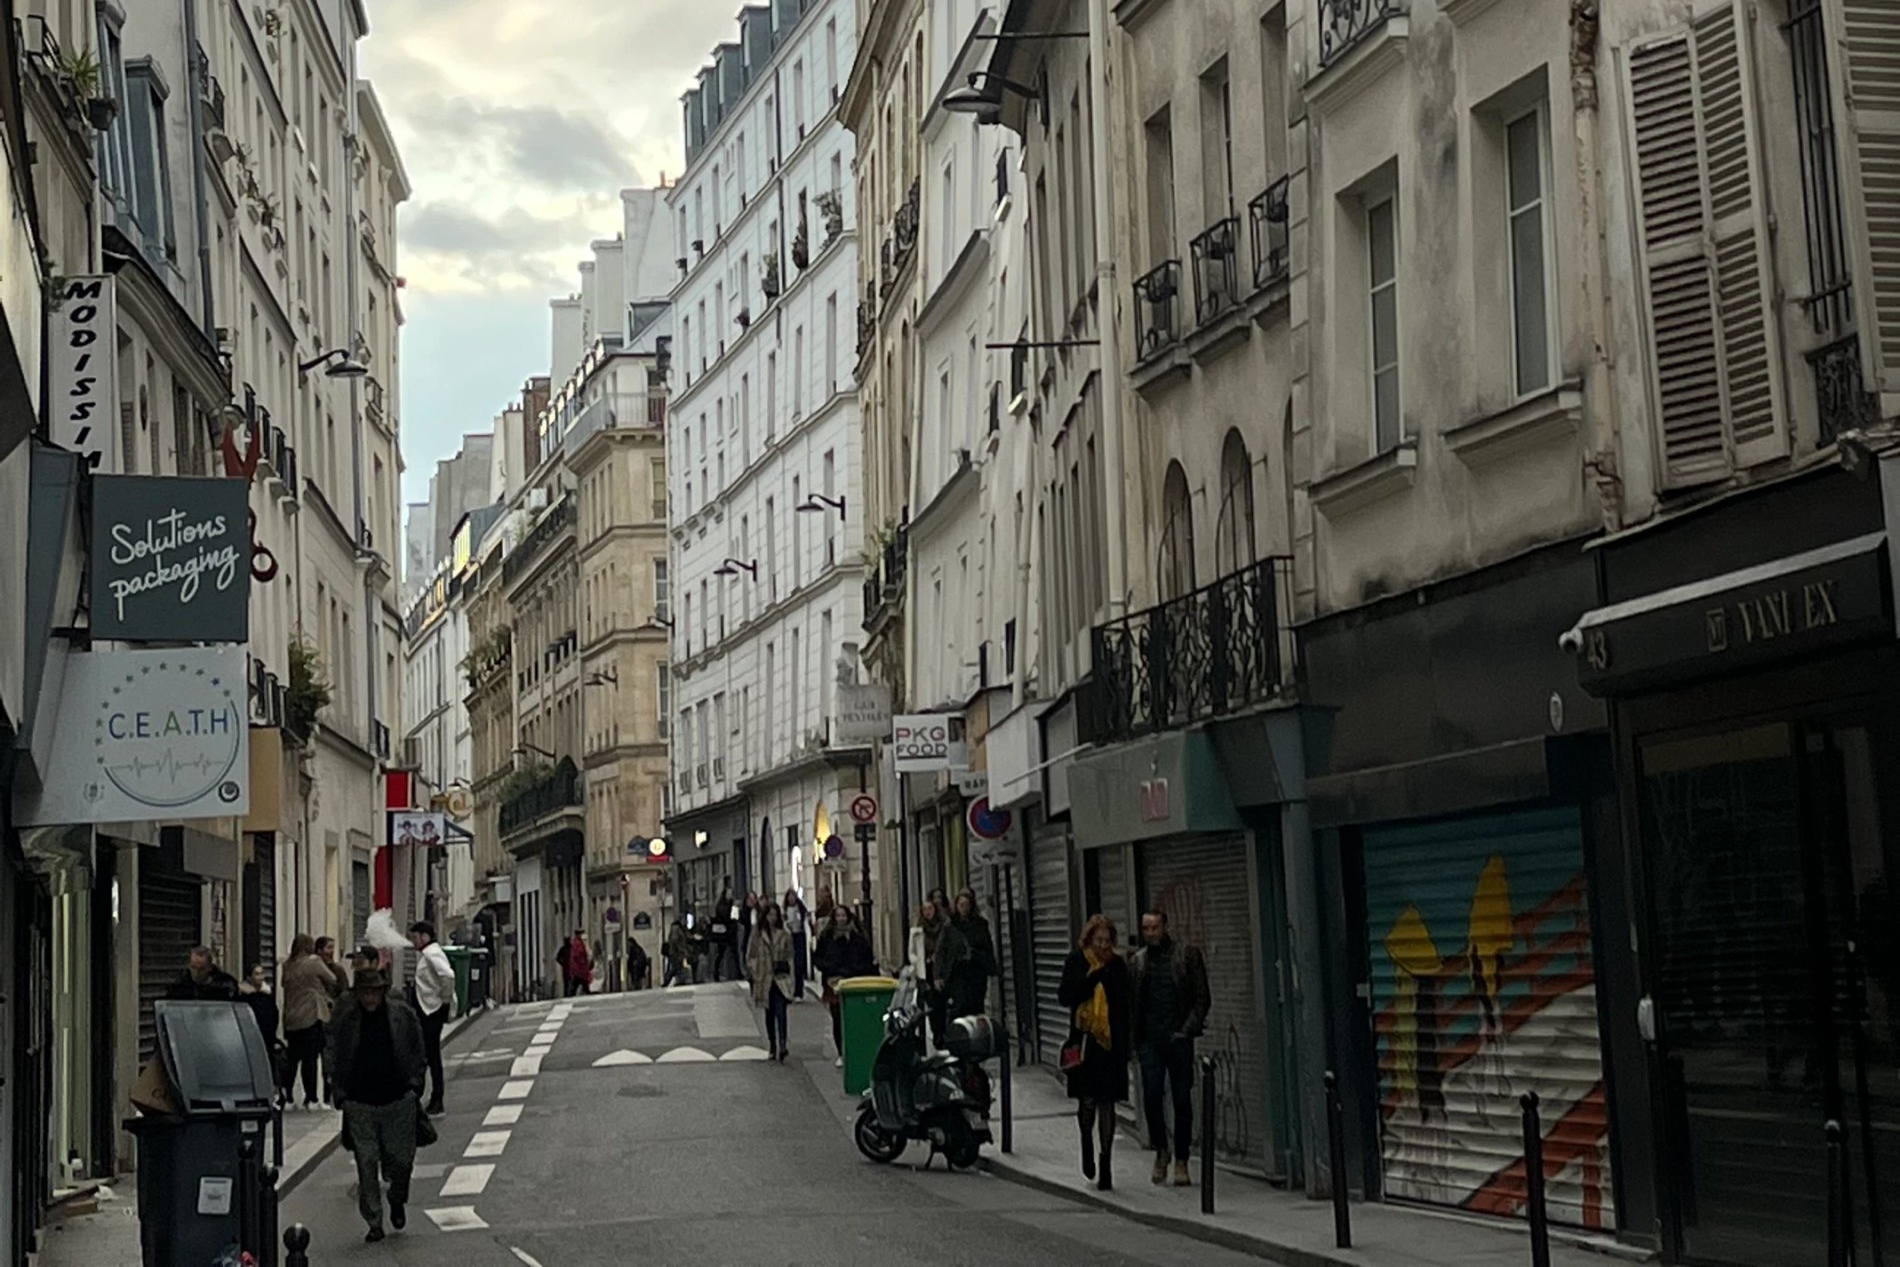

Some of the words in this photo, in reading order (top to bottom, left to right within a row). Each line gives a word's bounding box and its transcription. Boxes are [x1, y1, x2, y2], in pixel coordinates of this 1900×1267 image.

[111, 508, 227, 565] Solutions
[108, 545, 240, 621] packaging
[108, 707, 229, 740] C.E.A.T.H
[895, 726, 945, 743] PKG
[896, 743, 947, 756] FOOD
